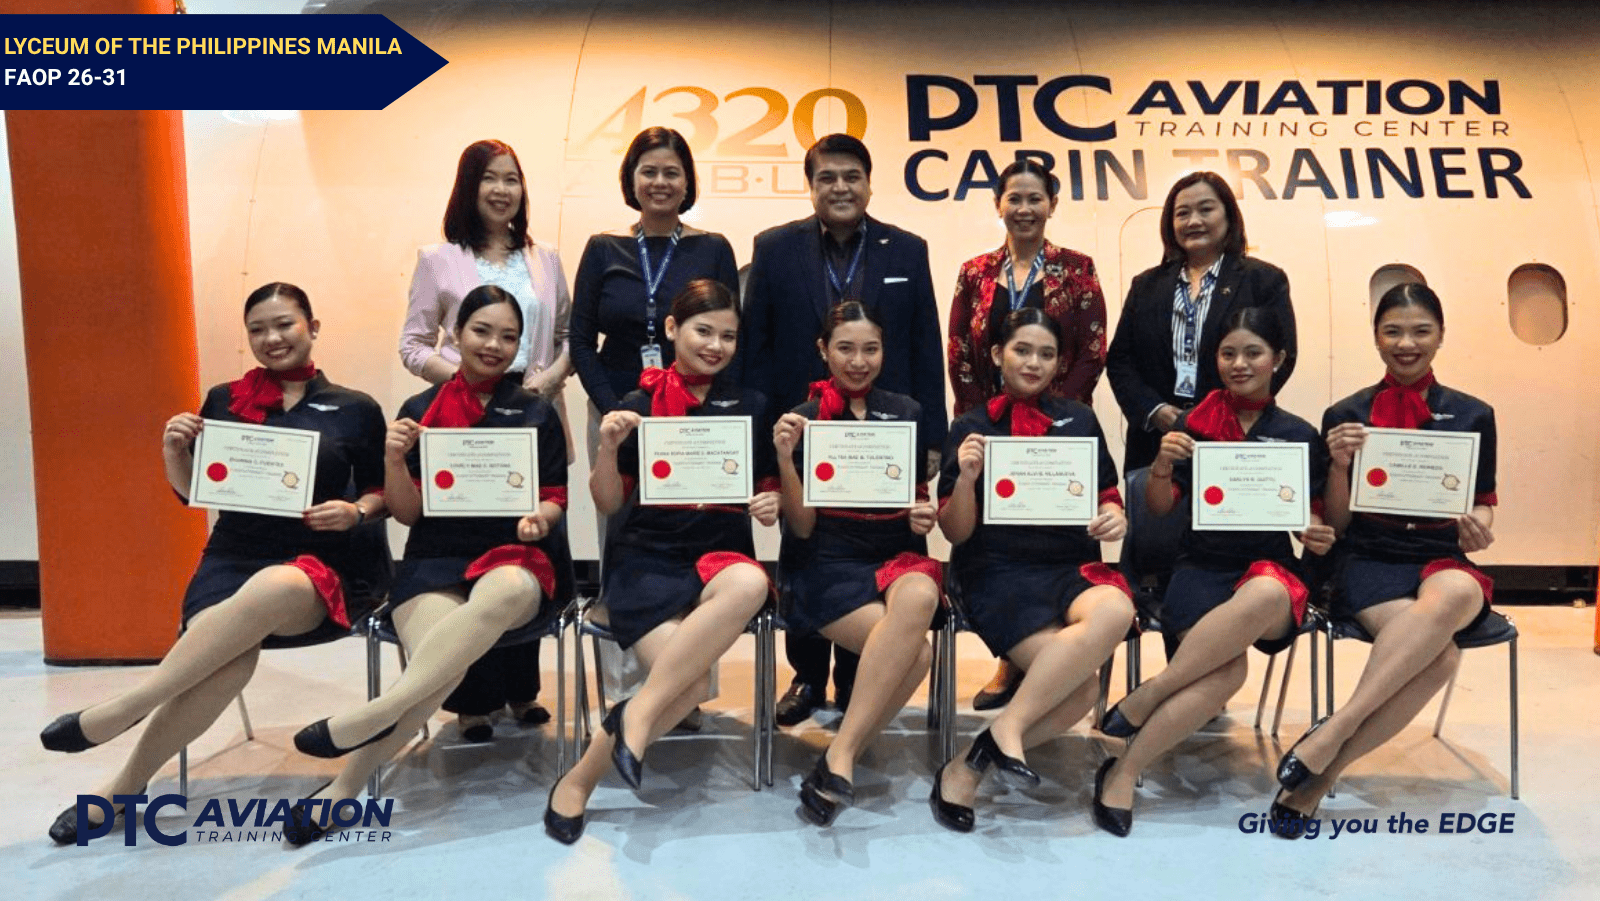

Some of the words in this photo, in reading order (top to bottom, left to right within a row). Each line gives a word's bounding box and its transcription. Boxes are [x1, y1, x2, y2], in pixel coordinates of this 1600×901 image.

[575, 85, 868, 158] A320
[907, 74, 1118, 142] PTC
[1127, 79, 1502, 116] AVIATION
[1137, 120, 1330, 137] TRAINING
[1354, 120, 1512, 137] CENTER
